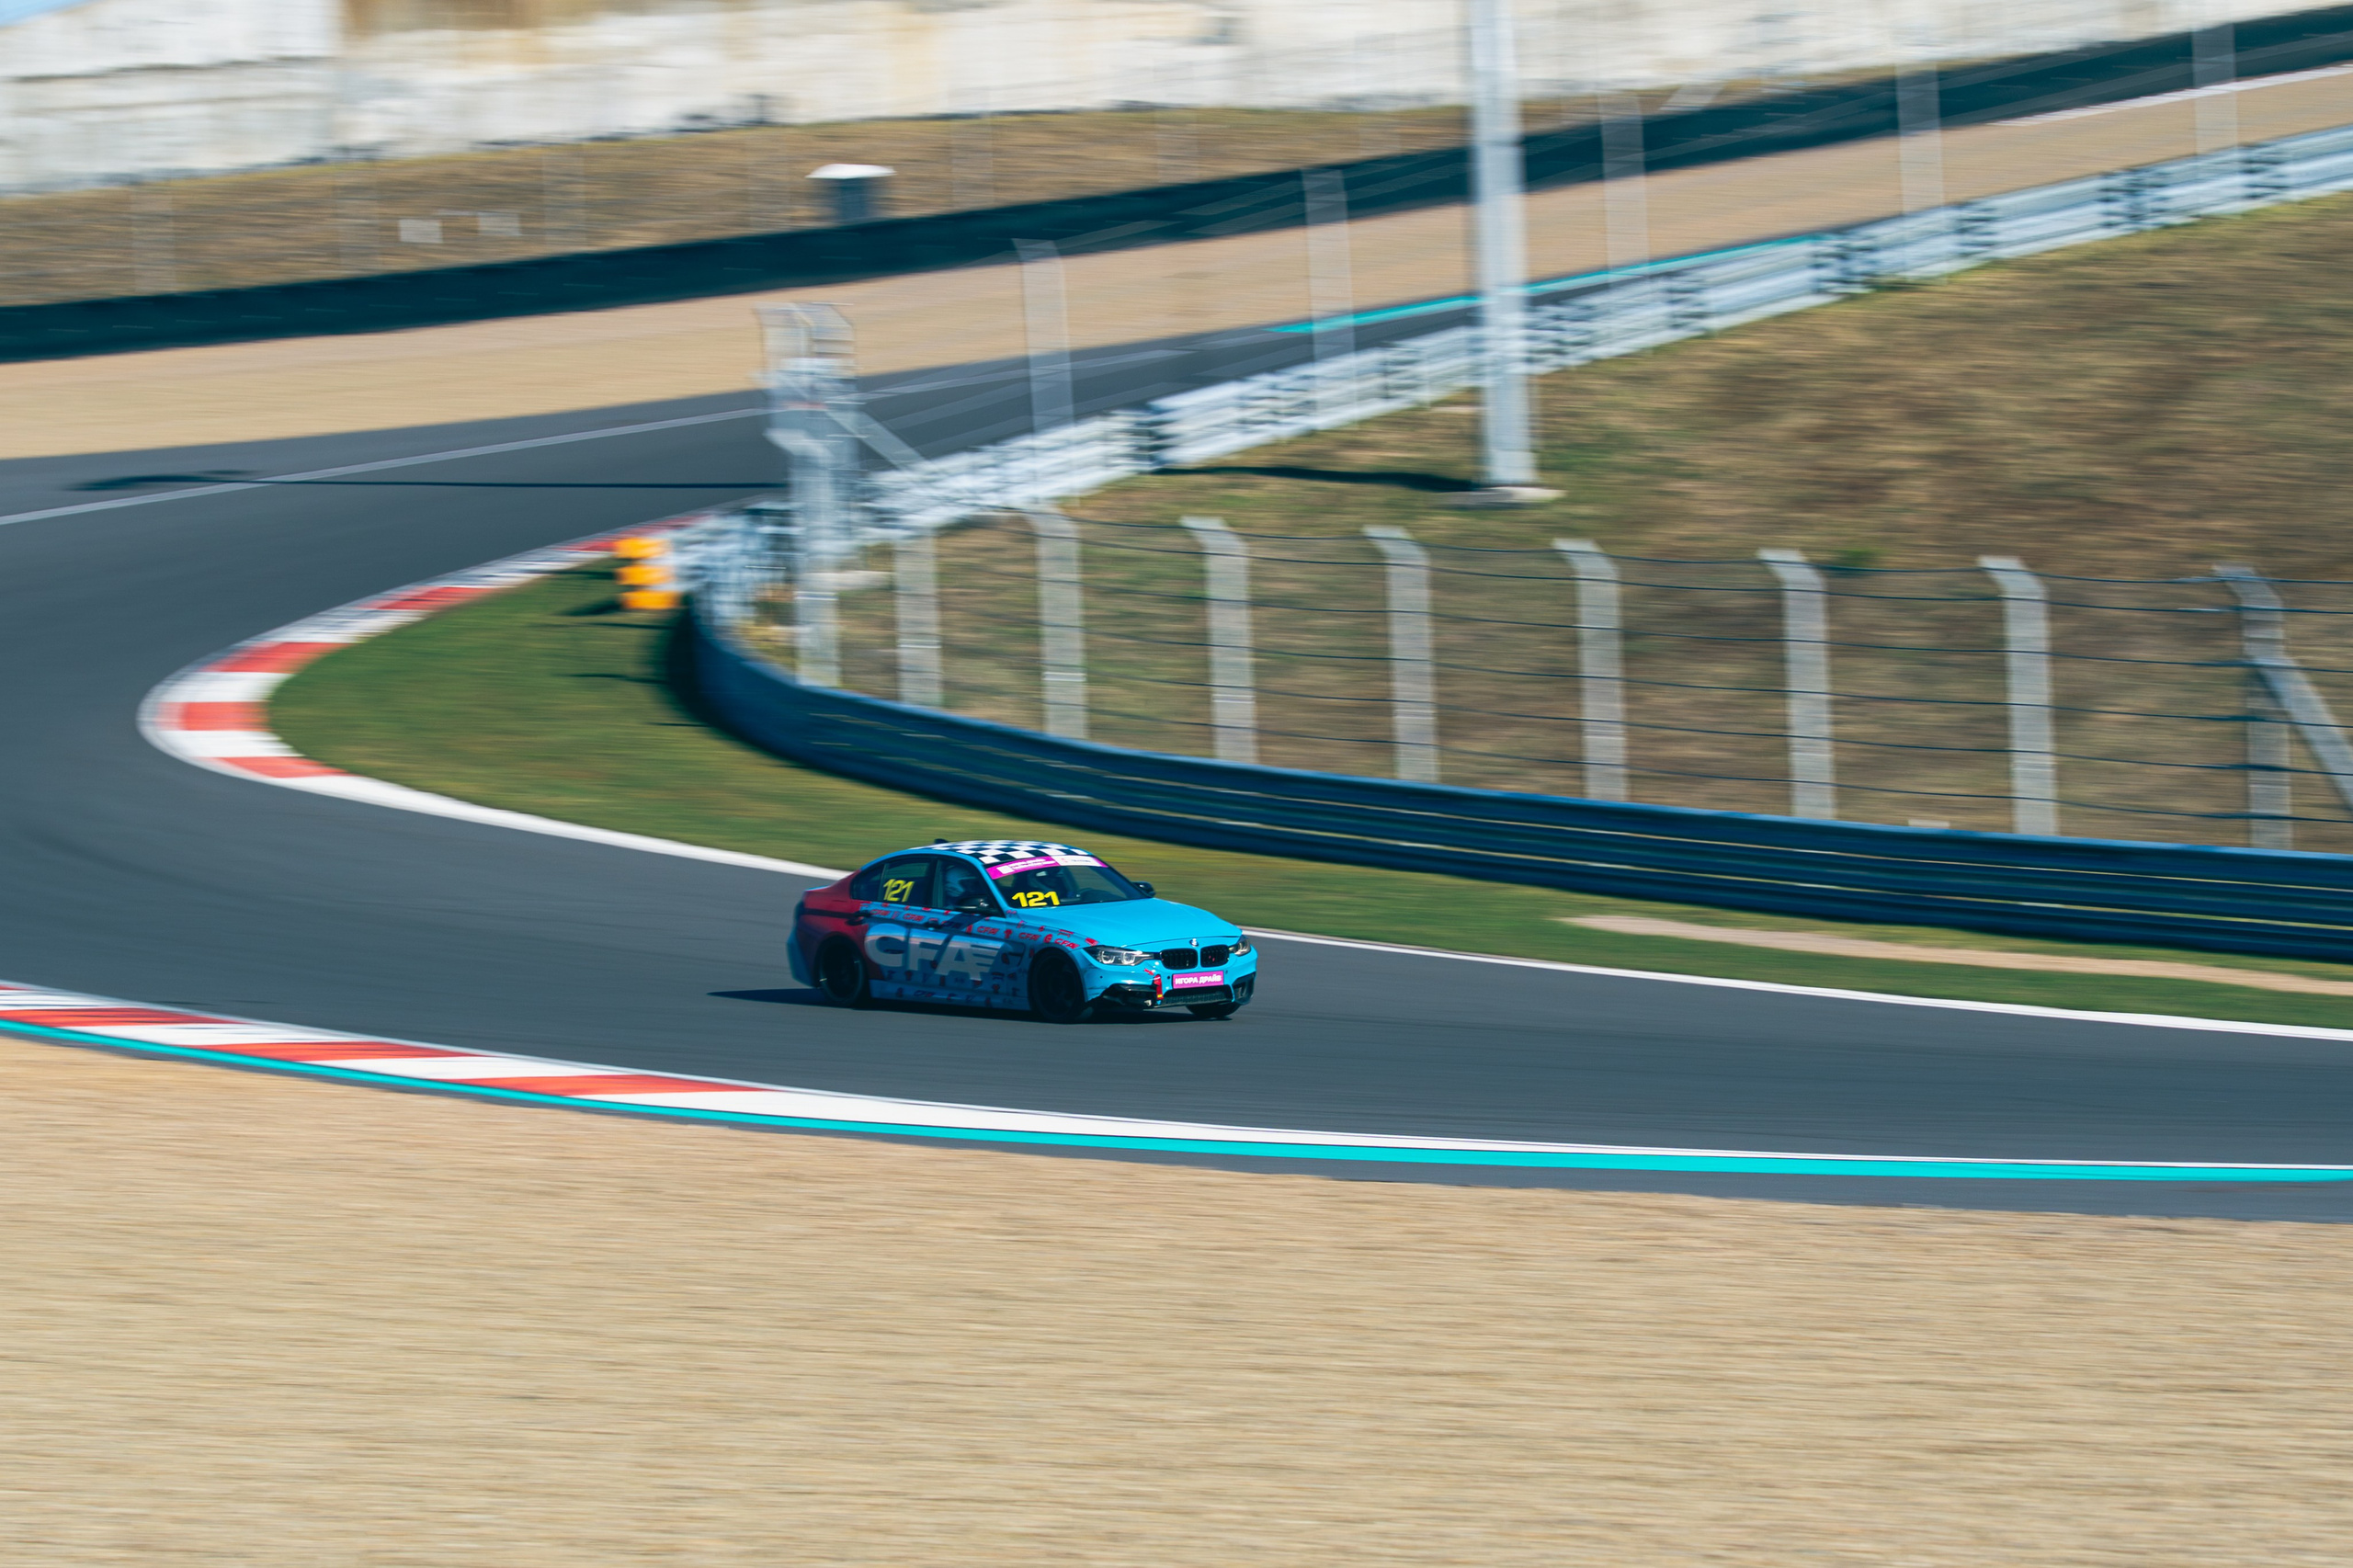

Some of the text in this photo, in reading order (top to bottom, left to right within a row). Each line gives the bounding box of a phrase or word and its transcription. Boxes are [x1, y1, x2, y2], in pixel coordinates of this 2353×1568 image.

[883, 879, 915, 902] 121
[1012, 891, 1060, 907] 121
[1175, 973, 1222, 985] ИГОРА ДРАЙВ
